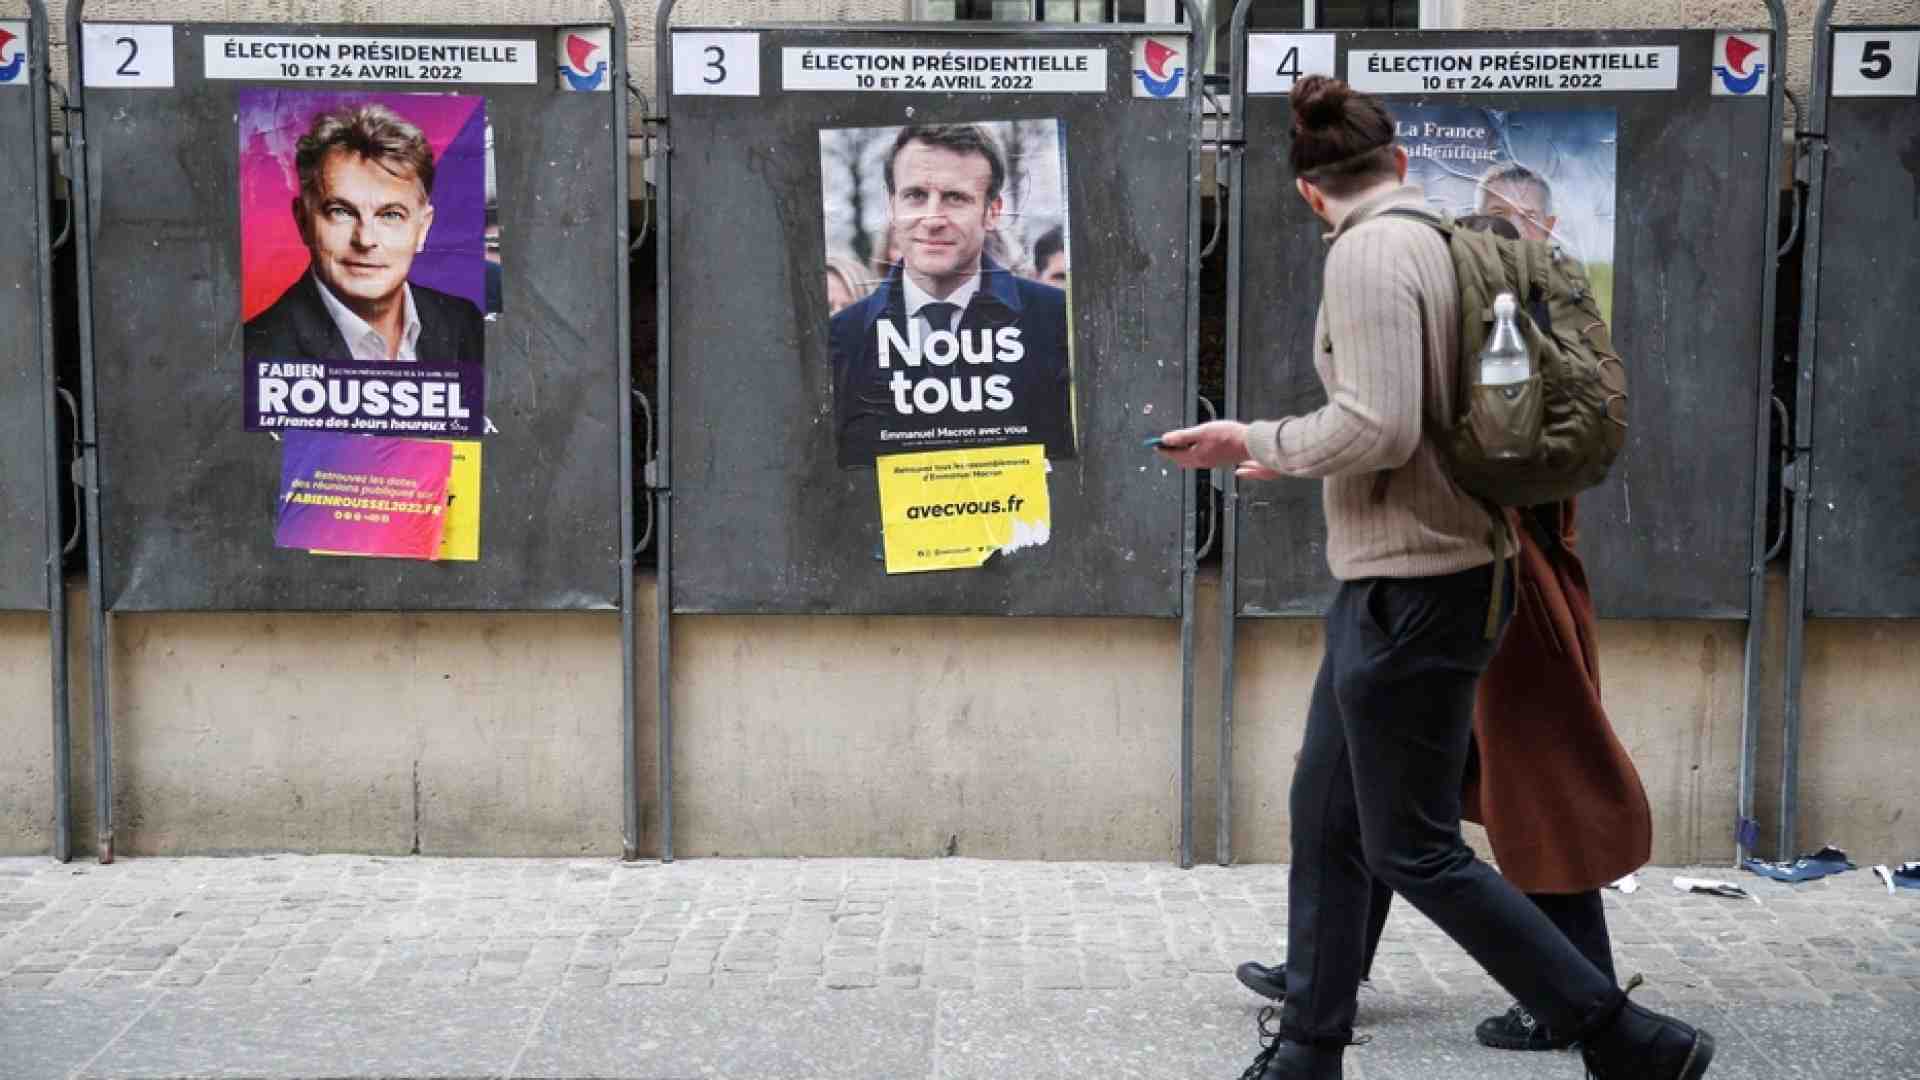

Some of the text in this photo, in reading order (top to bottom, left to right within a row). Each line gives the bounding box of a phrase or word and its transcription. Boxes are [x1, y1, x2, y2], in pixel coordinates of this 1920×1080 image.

[115, 36, 141, 76] 2
[224, 39, 518, 63] ÉLECTION PRÉSIDENTIELLE
[801, 51, 1088, 72] ÉLECTION PRÉSIDENTIELLE
[1368, 51, 1660, 72] ÉLECTION PRÉSIDENTIELLE
[1859, 40, 1892, 79] 5
[280, 64, 463, 80] 10 ET 24 AVRIL 2022
[702, 46, 727, 84] 3
[1276, 46, 1303, 84] 4
[857, 75, 1033, 90] 10 ET 24 AVRIL 2022
[1422, 73, 1602, 90] 10 ET 24 AVRIL 2022
[1394, 120, 1485, 138] La France
[1406, 143, 1497, 164] uthentique
[876, 318, 1025, 369] Nous
[258, 362, 325, 379] FABIEN
[258, 377, 470, 419] ROUSSEL
[889, 369, 1014, 415] tous
[259, 415, 275, 427] La
[277, 415, 323, 428] France
[325, 416, 349, 429] des
[390, 418, 447, 432] heureux
[880, 425, 1028, 441] Emmanuel Macron avec vous
[906, 493, 1024, 520] avecvous.fr
